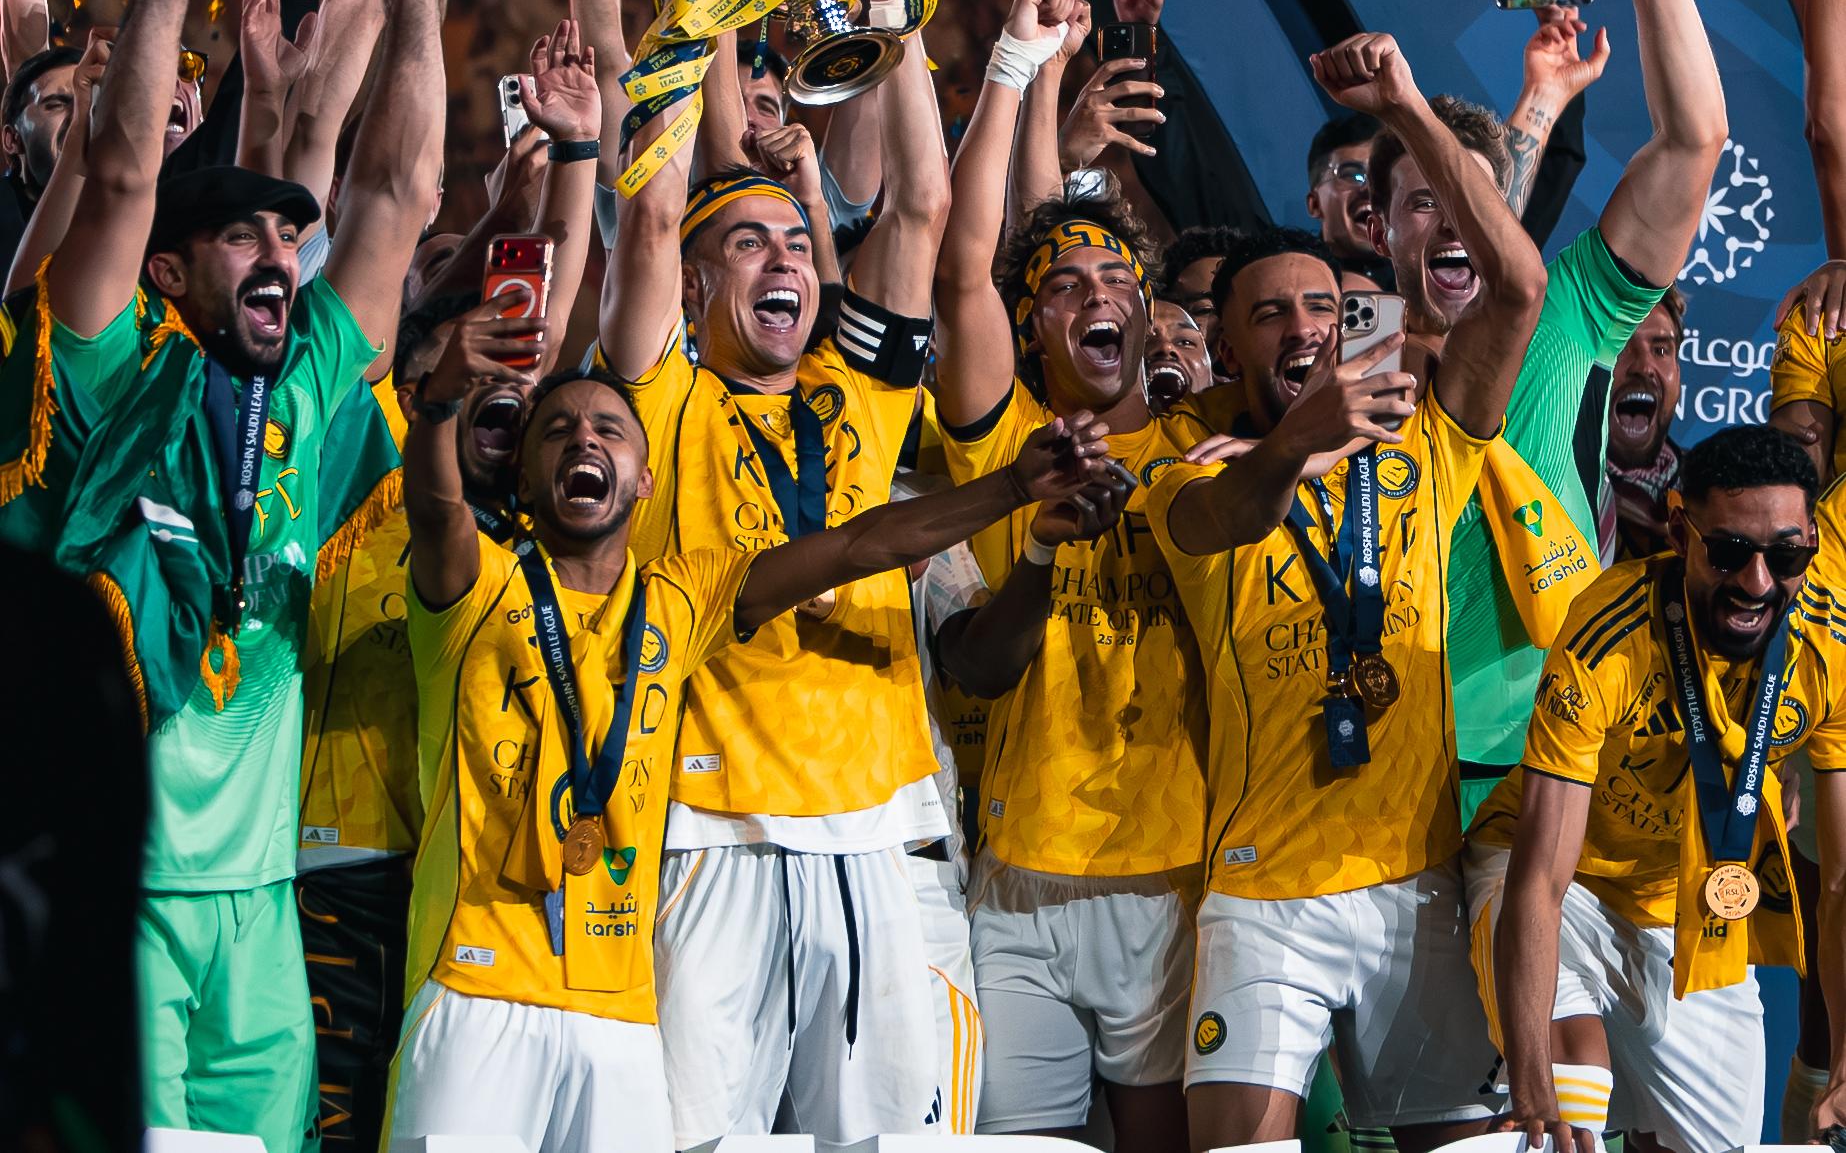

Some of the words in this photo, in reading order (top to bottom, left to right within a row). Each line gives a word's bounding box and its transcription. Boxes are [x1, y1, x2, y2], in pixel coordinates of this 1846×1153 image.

[250, 375, 265, 413] LEAGUE
[245, 414, 261, 446] SAUDI
[240, 447, 256, 486] ROSHN
[1357, 455, 1371, 493] LEAGUE
[1360, 492, 1372, 525] SAUDI
[1362, 527, 1373, 564] ROSHN
[1523, 535, 1578, 577] ترشيد
[1051, 564, 1172, 604] HAMPIO
[1529, 554, 1588, 595] tarshid
[541, 604, 561, 648] LEAGUE
[1048, 598, 1101, 626] TATE
[1097, 633, 1113, 646] 25
[1673, 626, 1689, 665] ROSHN
[551, 648, 567, 681] SAUDI
[1266, 647, 1325, 680] STAT
[1681, 667, 1696, 700] SAUDI
[1761, 673, 1777, 715] LEAGUE
[1688, 701, 1706, 744] LEAGUE
[1754, 716, 1769, 750] SAUDI
[489, 773, 534, 800] STA
[1745, 751, 1761, 791] ROSHN
[585, 892, 638, 919] شيد
[1725, 888, 1740, 896] RSL
[585, 921, 638, 937] tarsh
